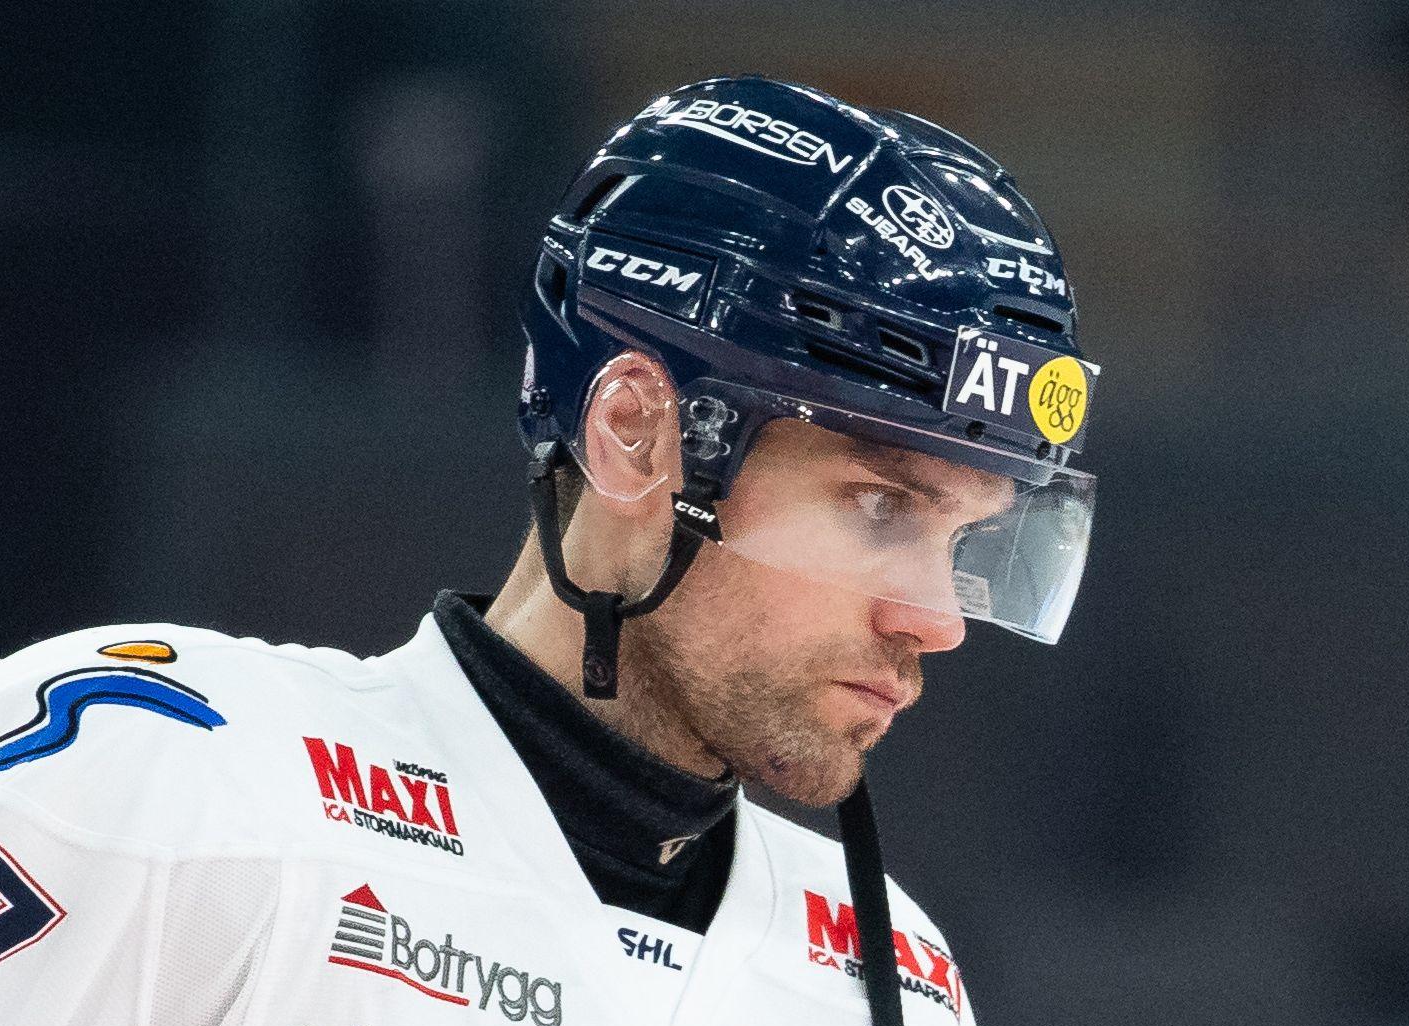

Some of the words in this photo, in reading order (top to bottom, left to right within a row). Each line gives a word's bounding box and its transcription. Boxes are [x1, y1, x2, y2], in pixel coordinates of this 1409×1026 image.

[846, 197, 941, 281] SUBARU
[586, 247, 702, 292] CCM
[985, 257, 1066, 296] CCM
[956, 338, 1030, 416] ÄT
[1039, 369, 1082, 432] ägg
[675, 501, 716, 523] CCM
[302, 736, 460, 836] MAXI
[323, 801, 352, 824] ICA
[617, 927, 683, 971] SHL
[808, 946, 841, 970] ICA
